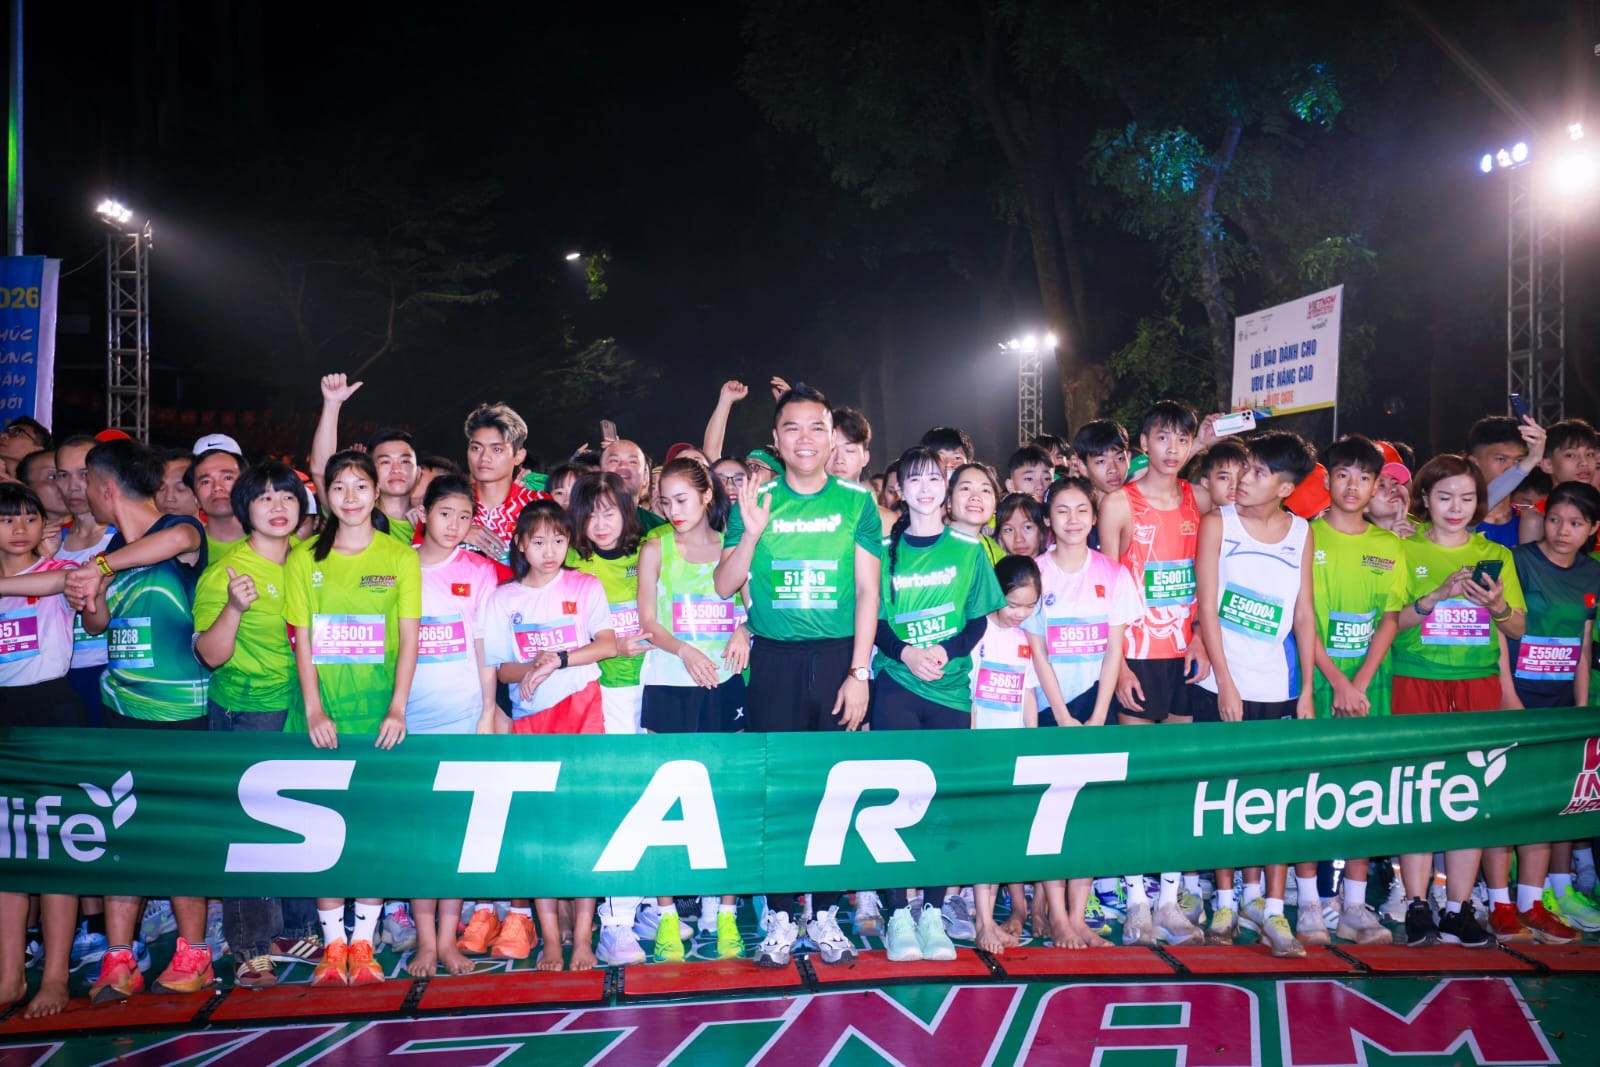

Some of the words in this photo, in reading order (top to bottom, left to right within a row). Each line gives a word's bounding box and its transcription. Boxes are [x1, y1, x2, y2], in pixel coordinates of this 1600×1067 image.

[1263, 345, 1277, 366] VÀO
[1279, 341, 1299, 363] DÀNH
[1301, 338, 1317, 358] CHO
[1298, 364, 1314, 384] CAO
[772, 516, 837, 533] Herbalife
[893, 571, 952, 591] Herbalife
[1153, 569, 1191, 585] E50011
[1230, 593, 1275, 620] E50004
[1435, 609, 1478, 623] 56393
[324, 625, 374, 641] E55001
[907, 616, 946, 637] 51347
[1060, 626, 1099, 641] 56518
[112, 629, 138, 645] 51268
[527, 629, 564, 646] 56513
[1529, 646, 1573, 660] E55002
[1193, 760, 1479, 836] Herbalife
[225, 752, 1129, 874] START
[0, 795, 107, 862] life
